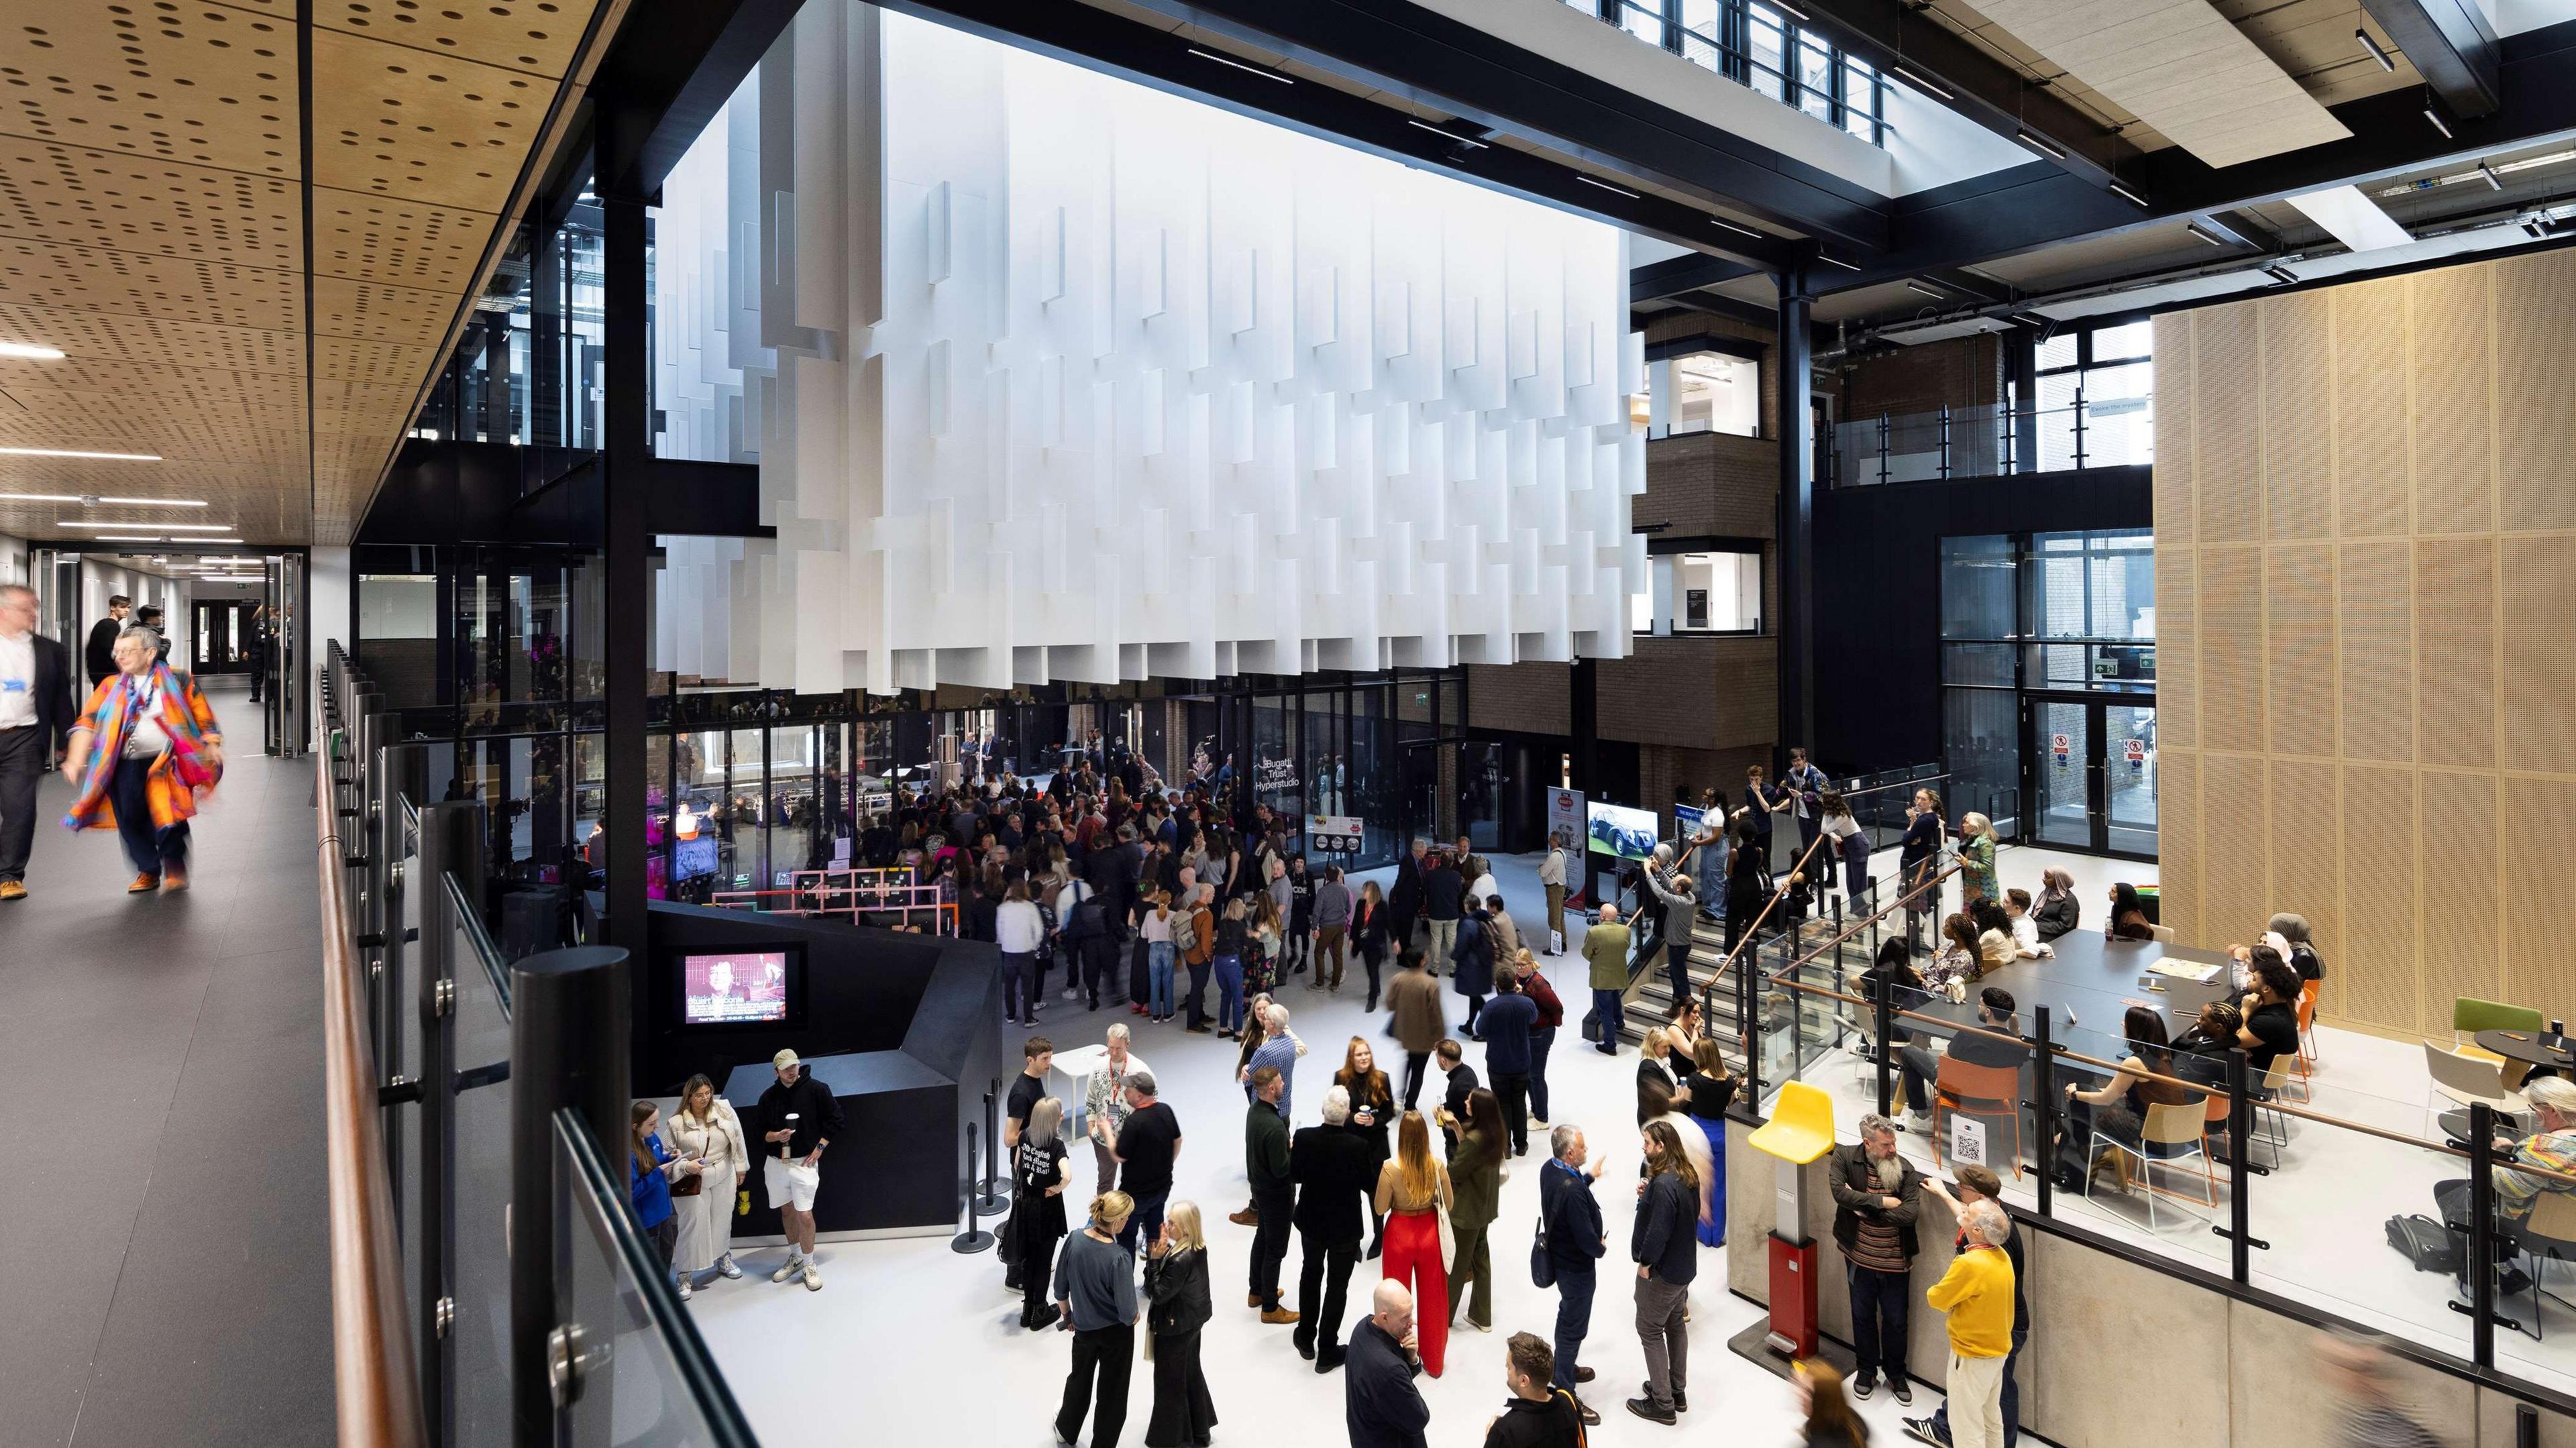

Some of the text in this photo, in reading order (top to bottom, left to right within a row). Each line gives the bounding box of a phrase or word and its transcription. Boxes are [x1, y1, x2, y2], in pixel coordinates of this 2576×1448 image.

[1267, 758, 1292, 769] Bugatti
[1268, 769, 1287, 778] Trust
[1255, 778, 1299, 792] Hyperstudio
[1023, 1152, 1050, 1168] lack Magic
[1030, 1147, 1051, 1160] English
